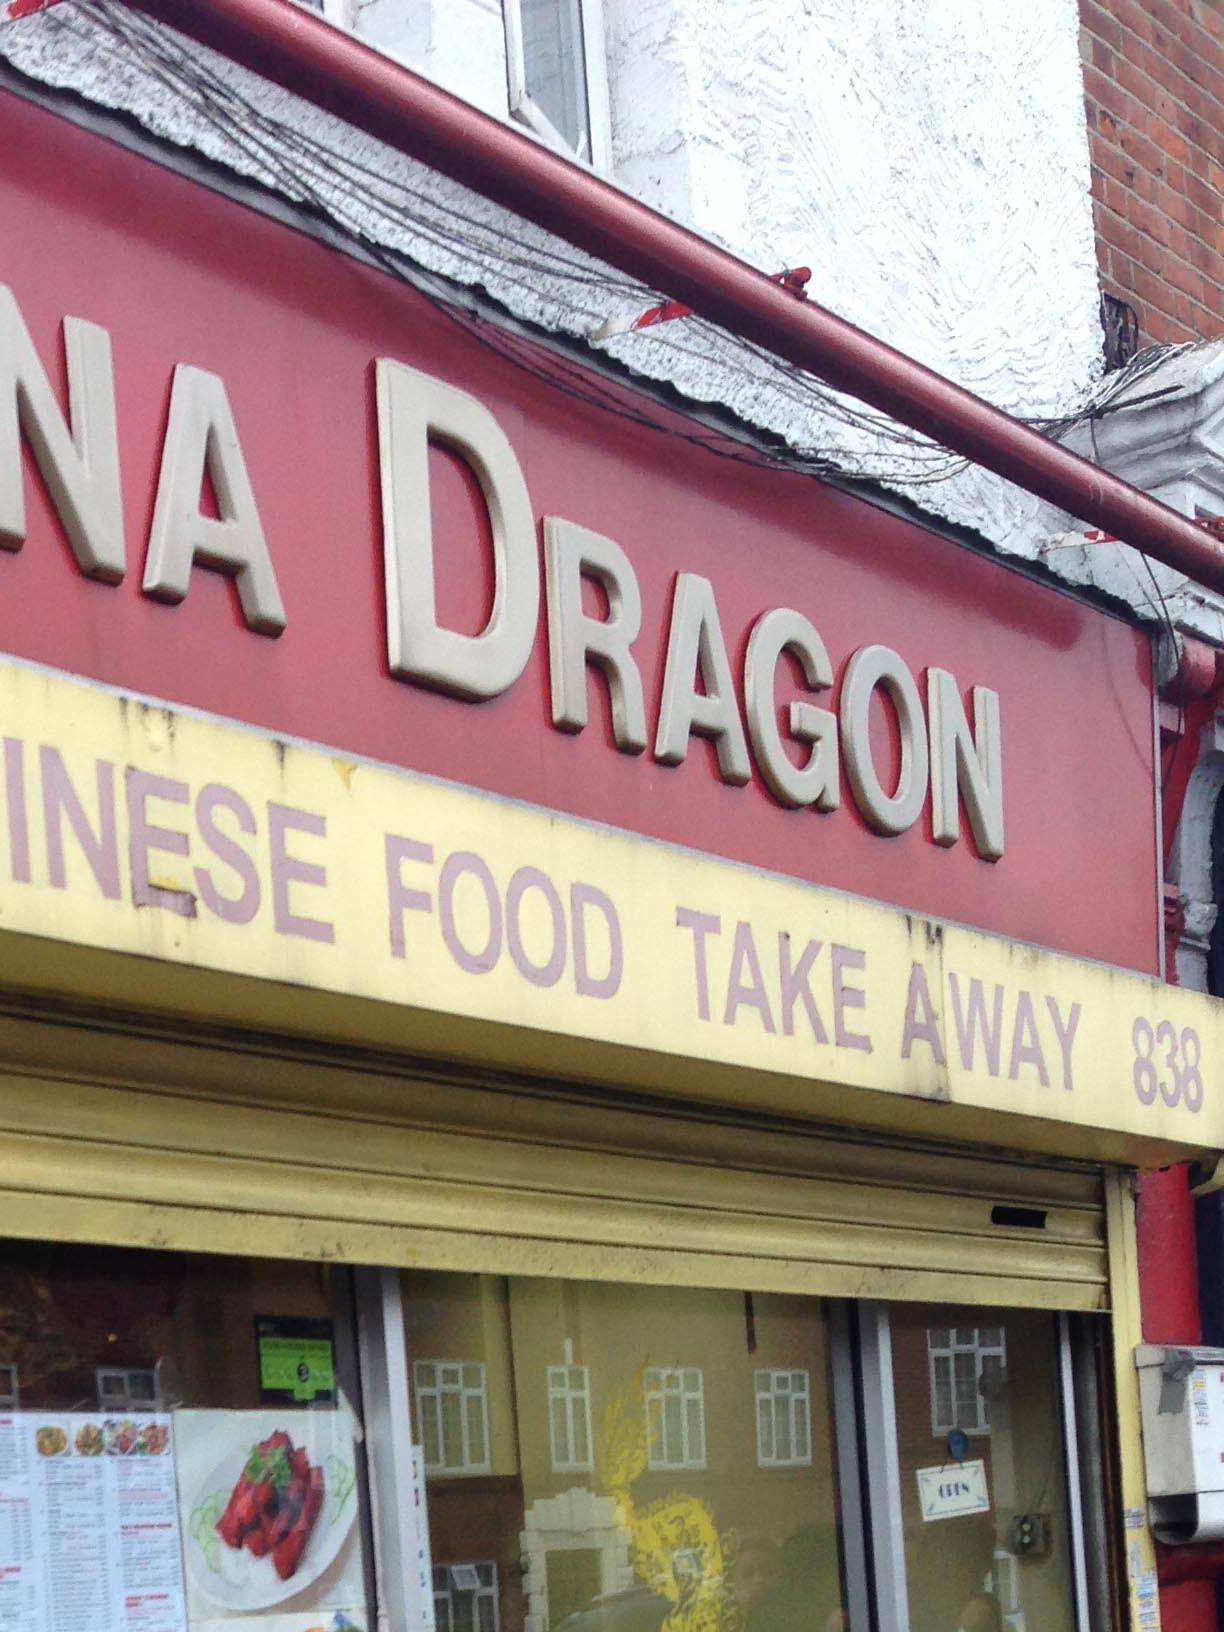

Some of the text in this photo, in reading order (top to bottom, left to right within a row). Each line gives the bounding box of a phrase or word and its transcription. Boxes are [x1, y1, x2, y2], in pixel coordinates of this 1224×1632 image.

[375, 356, 1005, 863] DRAGON
[383, 832, 624, 1000] FOOD
[675, 905, 873, 1054] TAKE
[1132, 1015, 1205, 1114] 838
